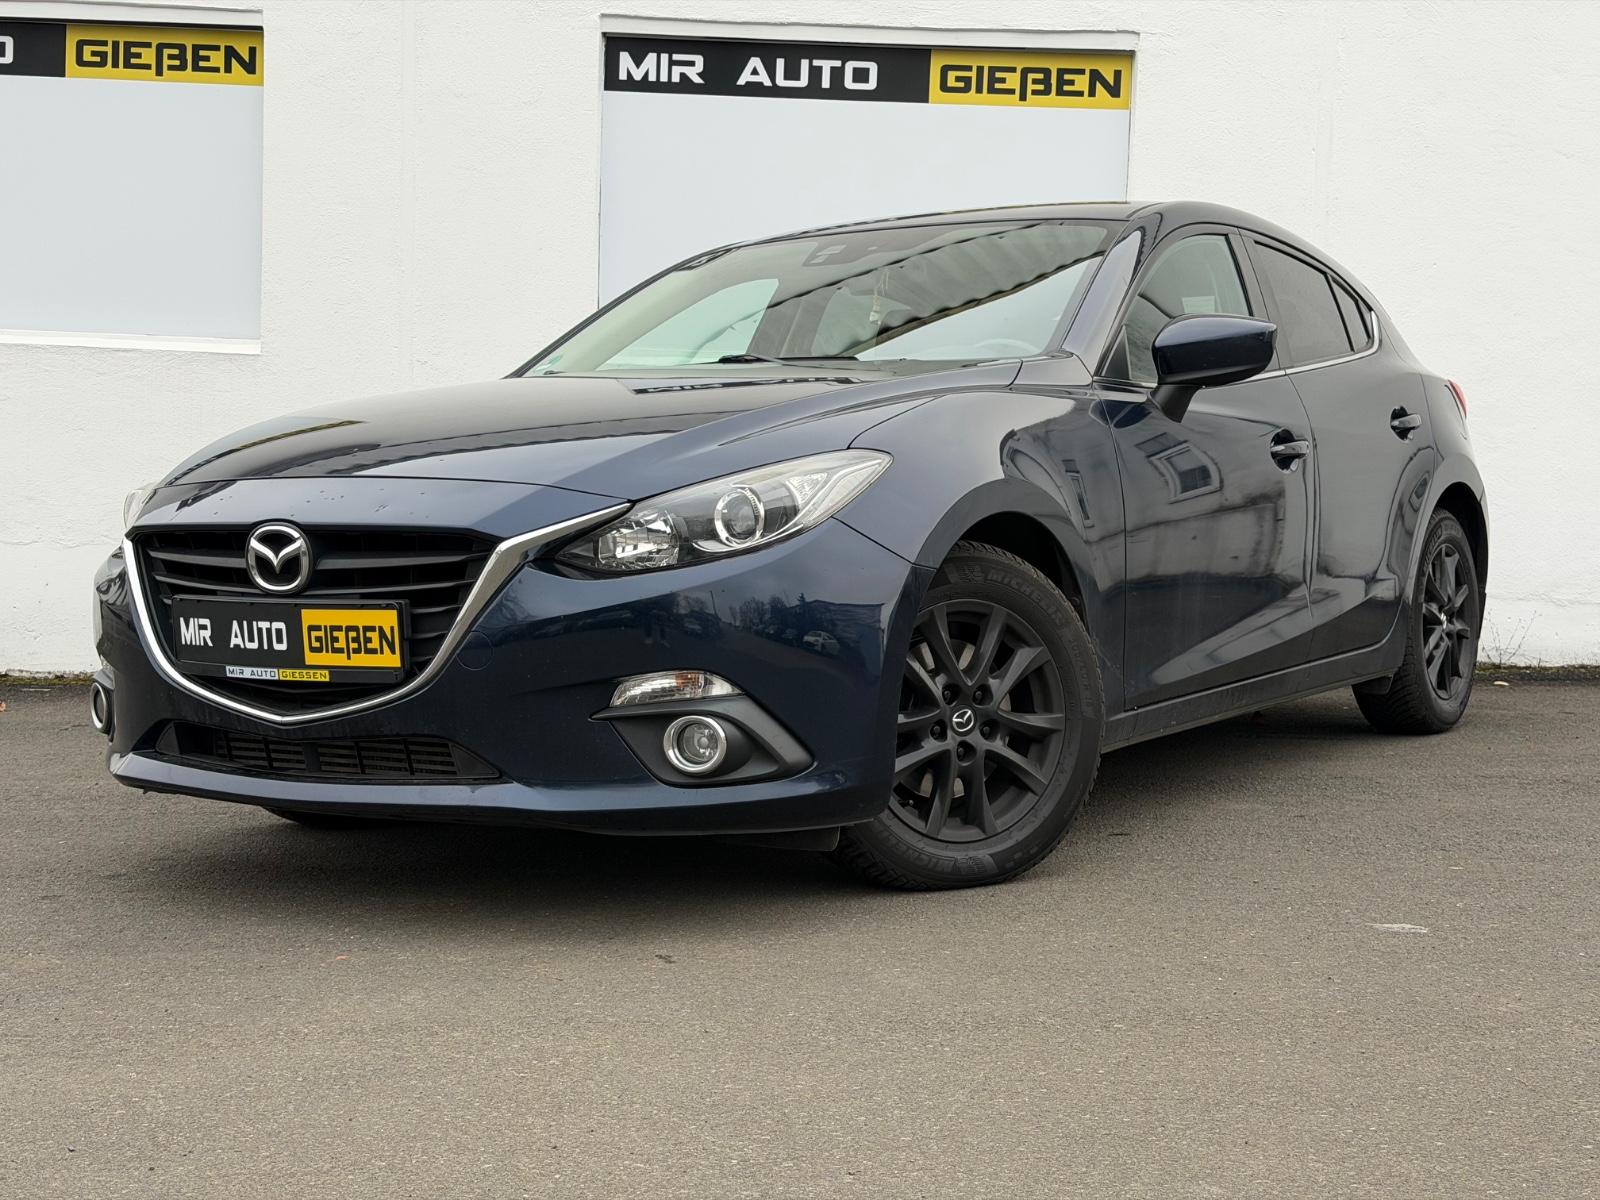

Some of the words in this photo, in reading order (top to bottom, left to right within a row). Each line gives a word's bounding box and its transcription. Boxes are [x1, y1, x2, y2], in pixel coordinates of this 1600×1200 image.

[75, 39, 257, 77] GIEßEN
[618, 51, 705, 85] MIR
[736, 57, 878, 91] AUTO
[939, 63, 1123, 103] GIEßEN
[179, 616, 213, 647] MIR
[229, 619, 288, 651] AUTO
[307, 624, 396, 660] GIEßEN
[227, 667, 245, 677] MIR
[250, 669, 277, 678] AUTO
[281, 670, 328, 680] GIESSEN
